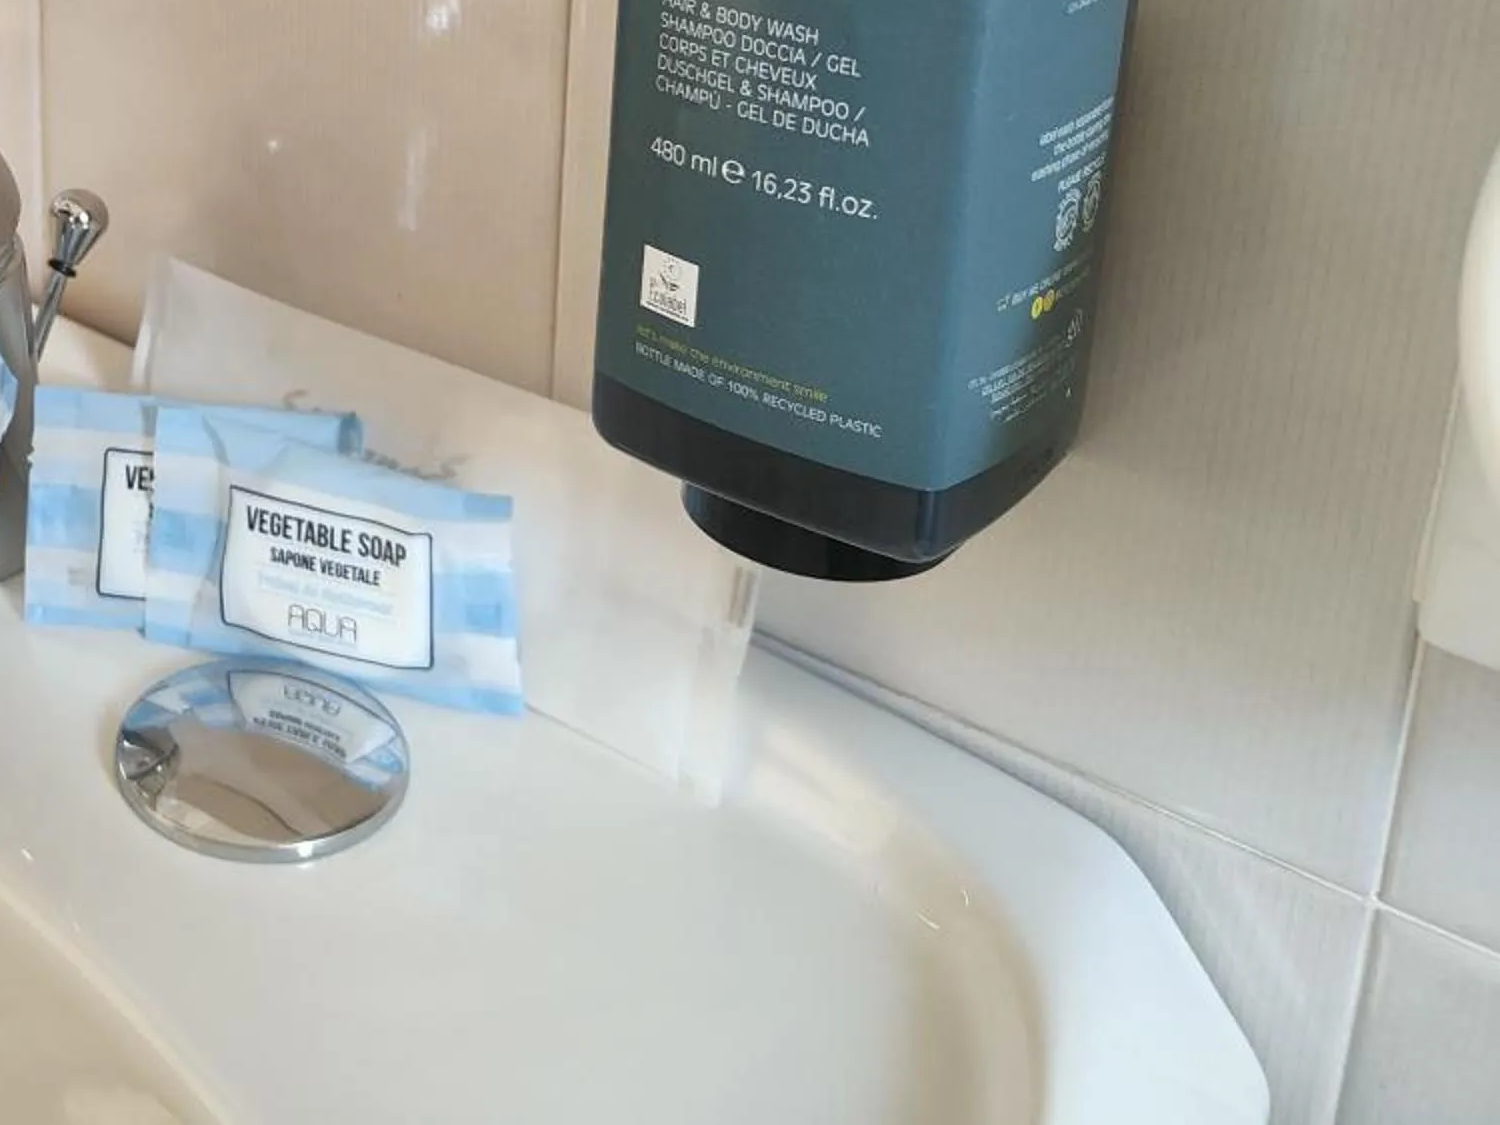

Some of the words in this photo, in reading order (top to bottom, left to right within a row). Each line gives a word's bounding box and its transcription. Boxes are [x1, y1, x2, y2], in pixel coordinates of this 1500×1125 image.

[661, 11, 737, 48] SHAMPOO
[741, 34, 806, 66] DOCCIA
[810, 52, 823, 68] /
[826, 54, 862, 78] GEL
[700, 1, 711, 20] &
[716, 6, 762, 32] BODY
[767, 18, 820, 46] WASH
[657, 53, 735, 93] DUSCHGEL
[740, 79, 753, 96] &
[757, 83, 849, 120] SHAMPOO
[853, 106, 866, 122] /
[659, 32, 708, 62] CORPS
[711, 49, 732, 69] ET
[735, 56, 817, 90] CHEVEUX
[737, 100, 769, 124] GEL
[771, 110, 797, 130] DE
[801, 116, 869, 147] DUCHA
[650, 136, 686, 167] 480
[691, 153, 718, 178] ml
[751, 170, 812, 205] 16,23
[635, 341, 672, 368] BOTTLE
[673, 357, 705, 381] MADE
[707, 372, 724, 386] OF
[727, 379, 759, 401] 100%
[762, 392, 826, 423] RECYCLED
[829, 413, 882, 438] PLASTIC
[247, 505, 352, 554] VEGETABLE
[357, 532, 407, 567] SOAP
[270, 546, 317, 572] SAPONE
[319, 558, 381, 586] VEGETALE
[287, 603, 357, 643] AQUA
